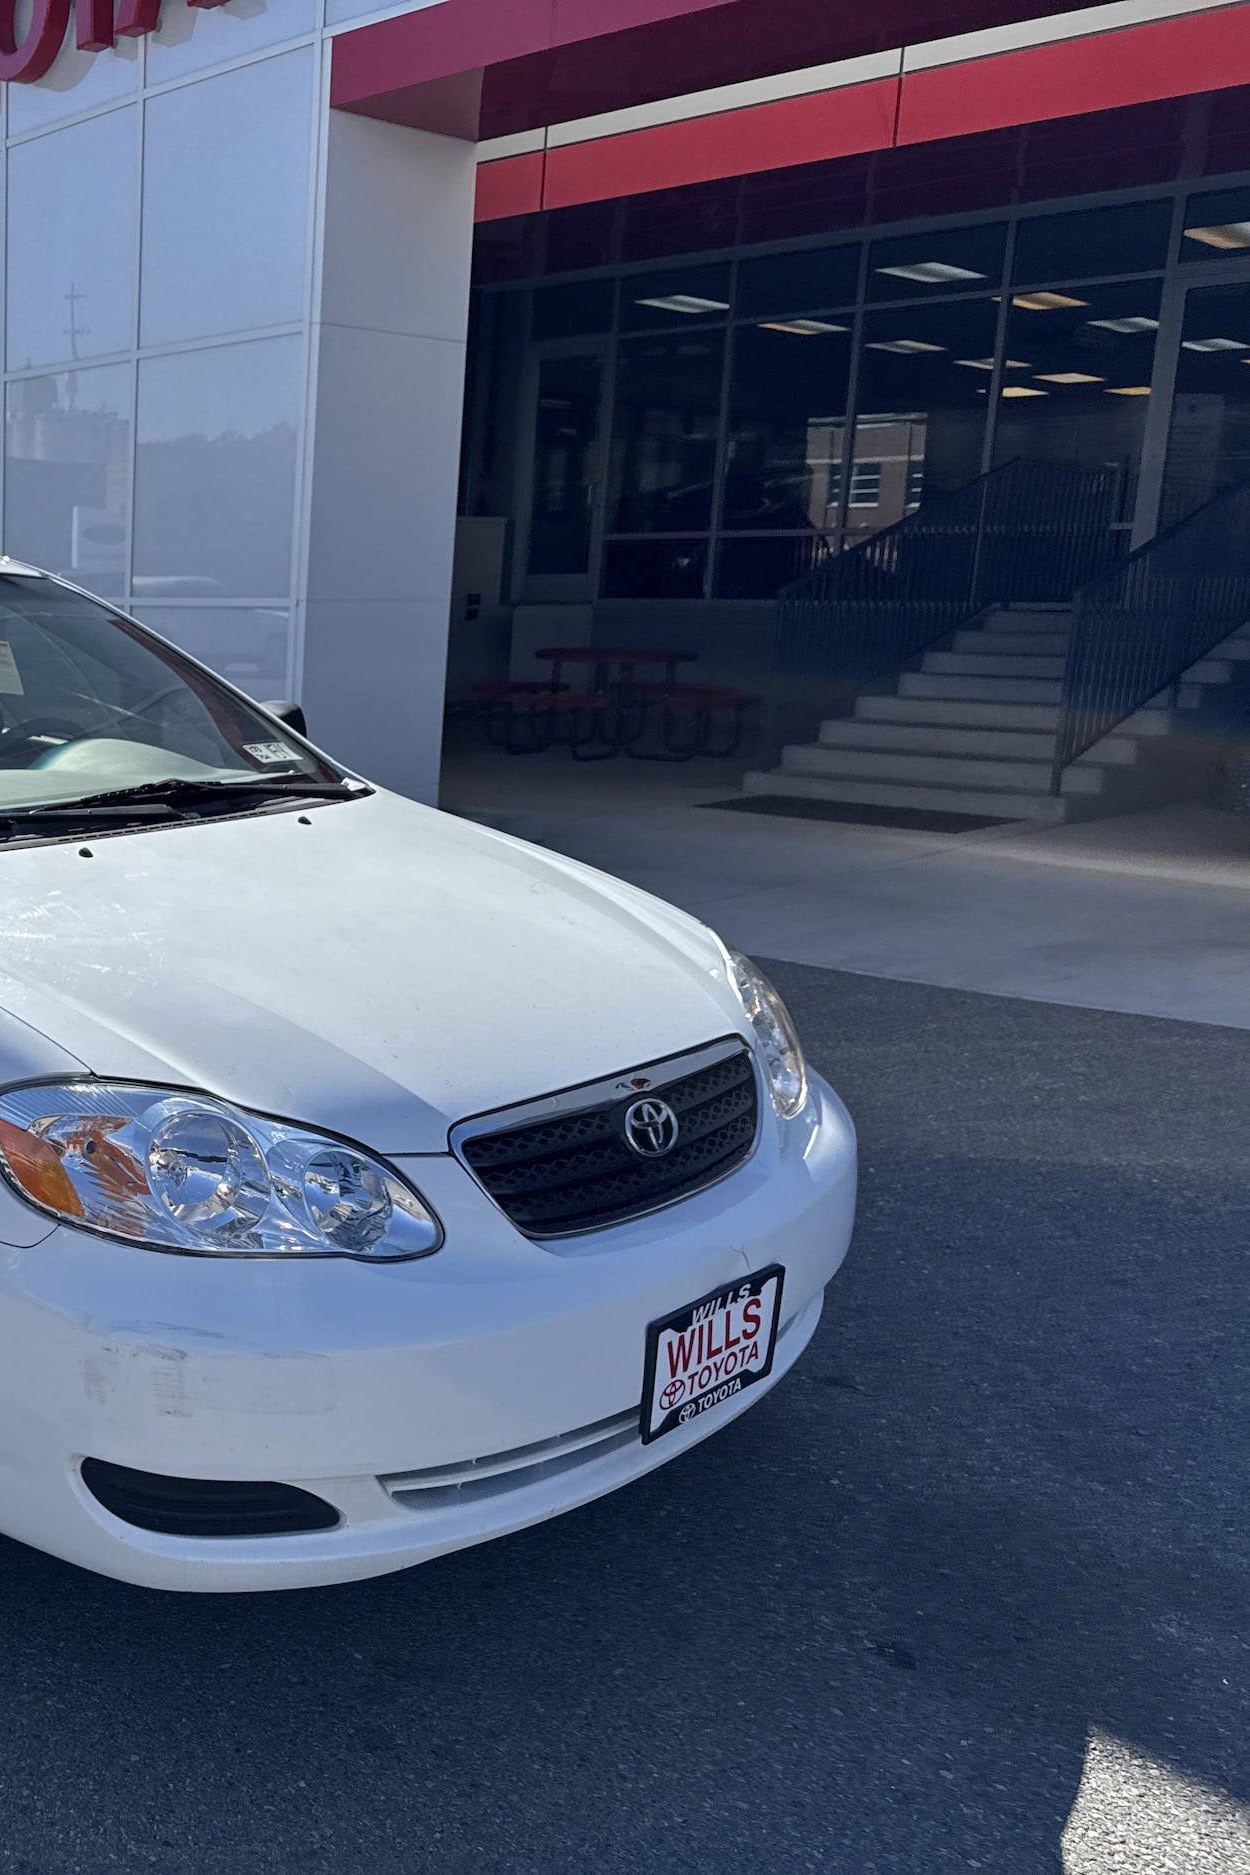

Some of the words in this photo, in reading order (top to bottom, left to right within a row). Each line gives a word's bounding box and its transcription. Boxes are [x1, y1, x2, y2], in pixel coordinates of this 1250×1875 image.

[692, 1284, 751, 1323] WILLS
[667, 1298, 761, 1378] WILLS
[688, 1341, 758, 1395] TOYOTA
[698, 1378, 741, 1412] TOYOTA
